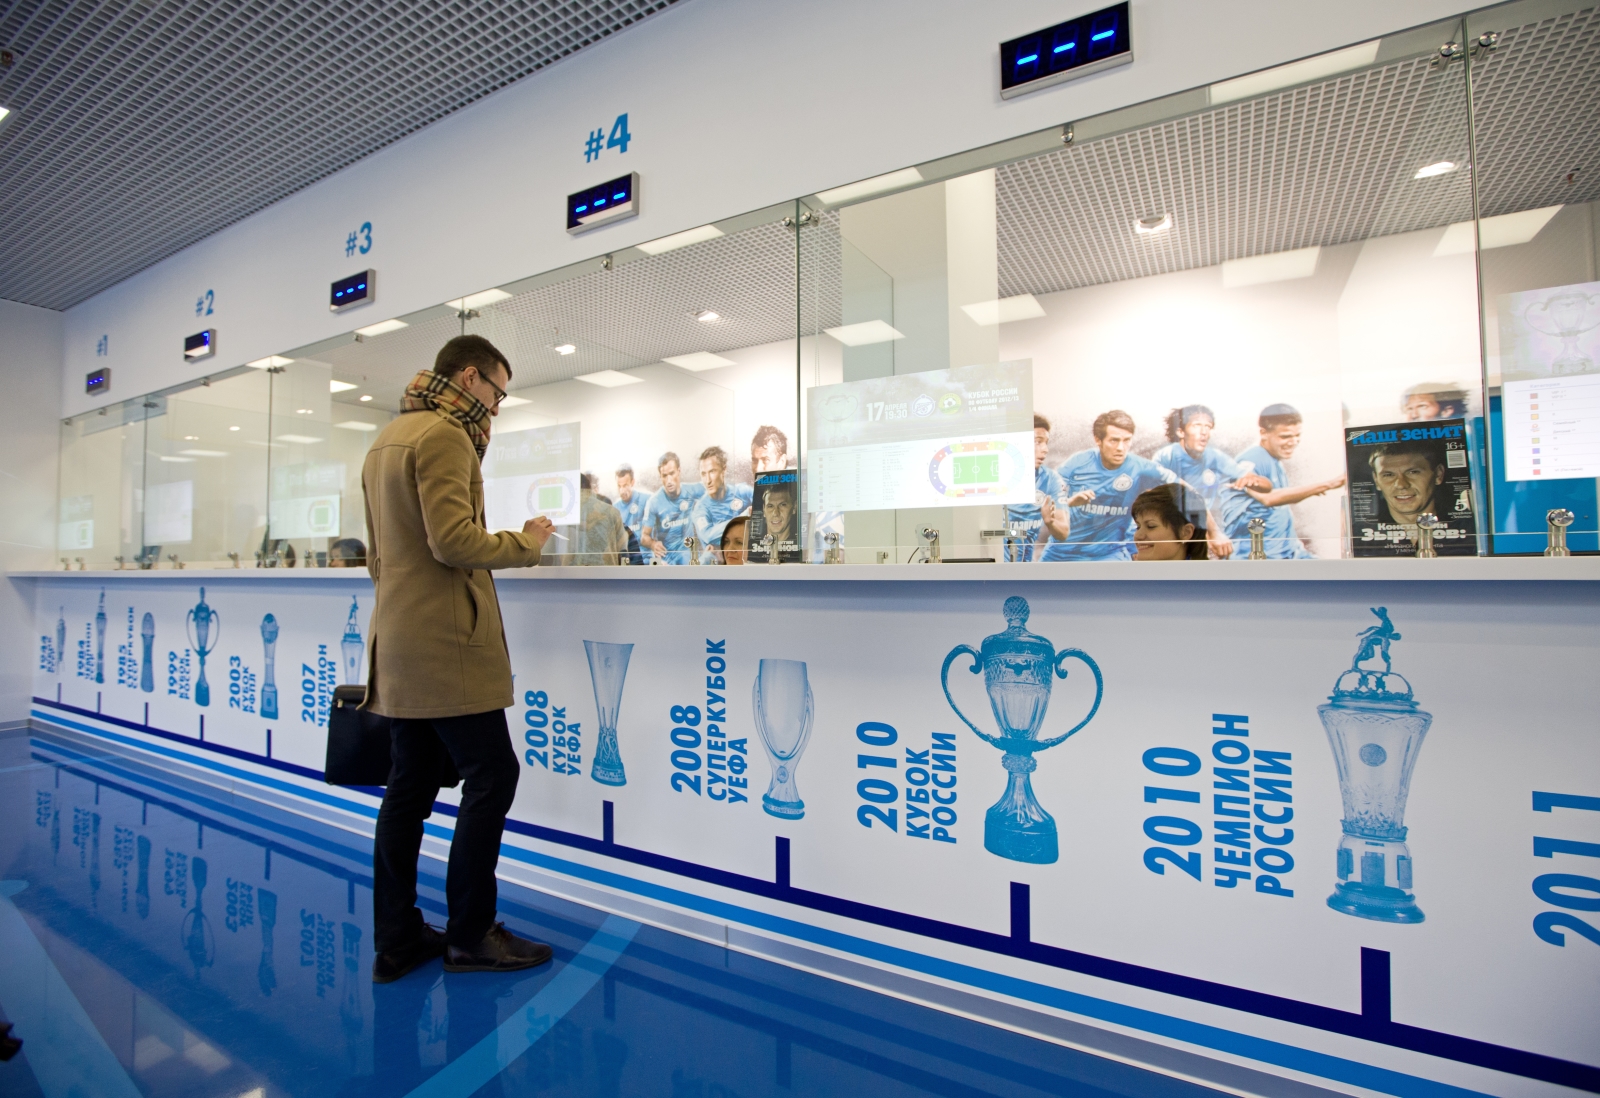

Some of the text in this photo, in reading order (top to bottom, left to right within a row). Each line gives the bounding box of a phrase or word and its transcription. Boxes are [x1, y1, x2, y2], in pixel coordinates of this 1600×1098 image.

[584, 113, 631, 163] #4
[345, 221, 373, 257] #3
[195, 289, 216, 317] #2
[866, 402, 907, 422] 17 АПРЕЛЯ
[885, 410, 908, 420] 19:30
[968, 387, 1018, 399] КУБОК РОССИИ
[1445, 442, 1465, 450] 16+
[1377, 522, 1448, 531] Констаин
[1454, 499, 1468, 512] 5
[1361, 528, 1467, 544] Зыряов:
[77, 640, 85, 677] 1984
[117, 644, 126, 685] 1985
[126, 606, 134, 688] СУПЕРКУБОК
[168, 651, 178, 696] 1999
[178, 657, 186, 699] КУБОК
[229, 655, 241, 709] 2003
[242, 666, 250, 712] КУБОК
[302, 663, 316, 724] 2007
[318, 643, 327, 727] ЧЕМПИОН
[327, 661, 336, 728] ССИИ
[525, 690, 549, 770] 2008
[552, 705, 567, 774] КУБОК
[706, 638, 727, 801] СУПЕРКУБОК
[566, 722, 581, 776] УЕФА
[670, 704, 702, 796] 2008
[728, 737, 748, 804] УЕФА
[856, 722, 898, 832] 2010
[906, 747, 932, 840] КУБОК
[931, 732, 957, 844] РОССИИ
[1213, 714, 1250, 890] ЧЕМПИОН
[1142, 746, 1201, 882] 2010
[1254, 749, 1295, 898] РОССИИ
[1531, 790, 1600, 948] 2011
